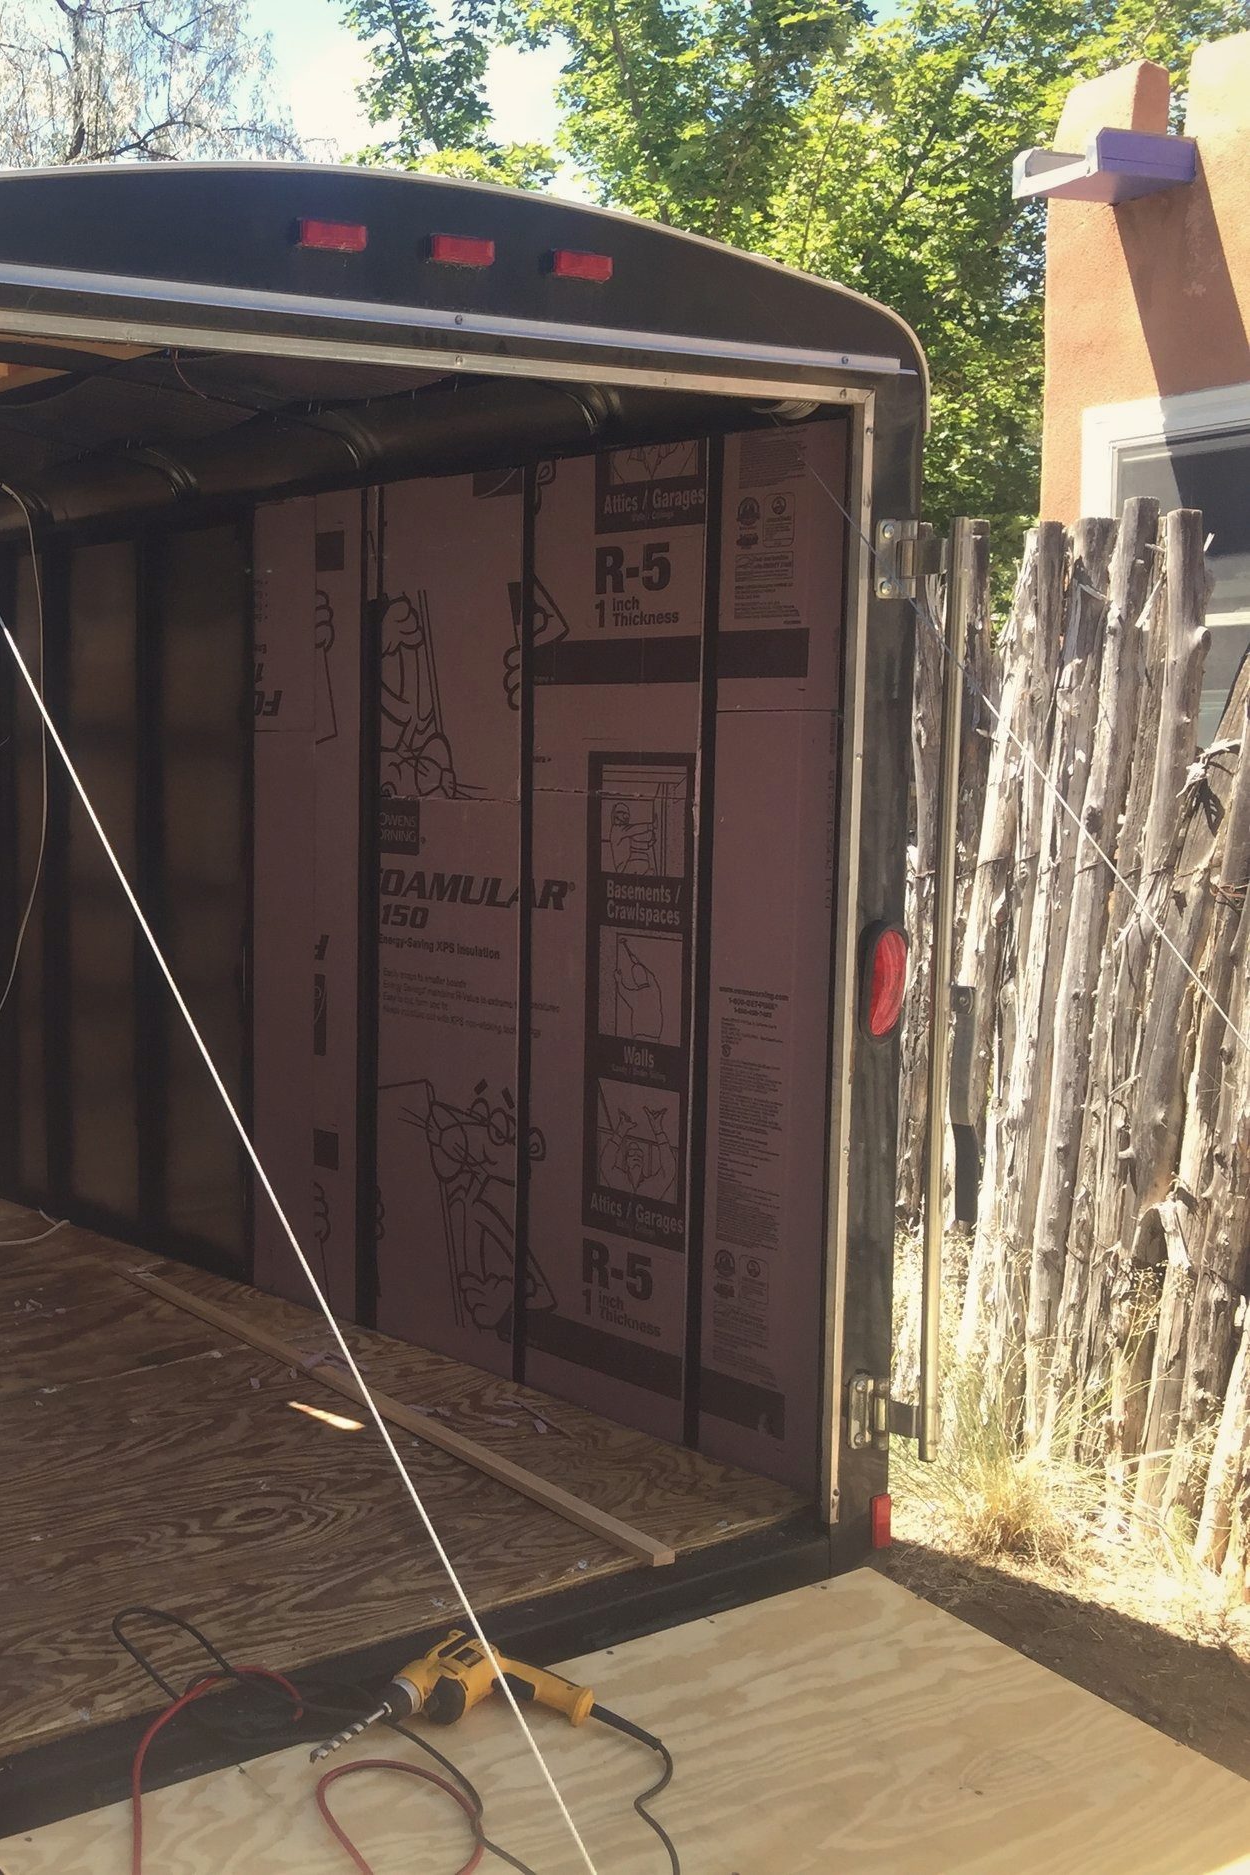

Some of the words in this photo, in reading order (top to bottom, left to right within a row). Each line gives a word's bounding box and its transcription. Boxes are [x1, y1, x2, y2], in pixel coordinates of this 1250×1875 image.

[603, 492, 638, 514] Attics
[652, 487, 705, 512] Garages
[595, 542, 671, 594] R-5
[595, 599, 605, 628] 1
[612, 611, 679, 627] Thickness
[380, 828, 417, 842] RNING
[380, 868, 568, 911] OAMULAR
[606, 879, 670, 904] Basements
[381, 904, 429, 929] 150
[606, 899, 681, 927] Crawlspaces
[436, 941, 454, 954] XPS
[624, 1045, 655, 1068] Walls
[590, 1192, 622, 1218] Attics
[635, 1203, 684, 1234] Garages
[582, 1237, 653, 1301] R-5
[582, 1289, 592, 1315] 1
[598, 1305, 661, 1337] Thickness
